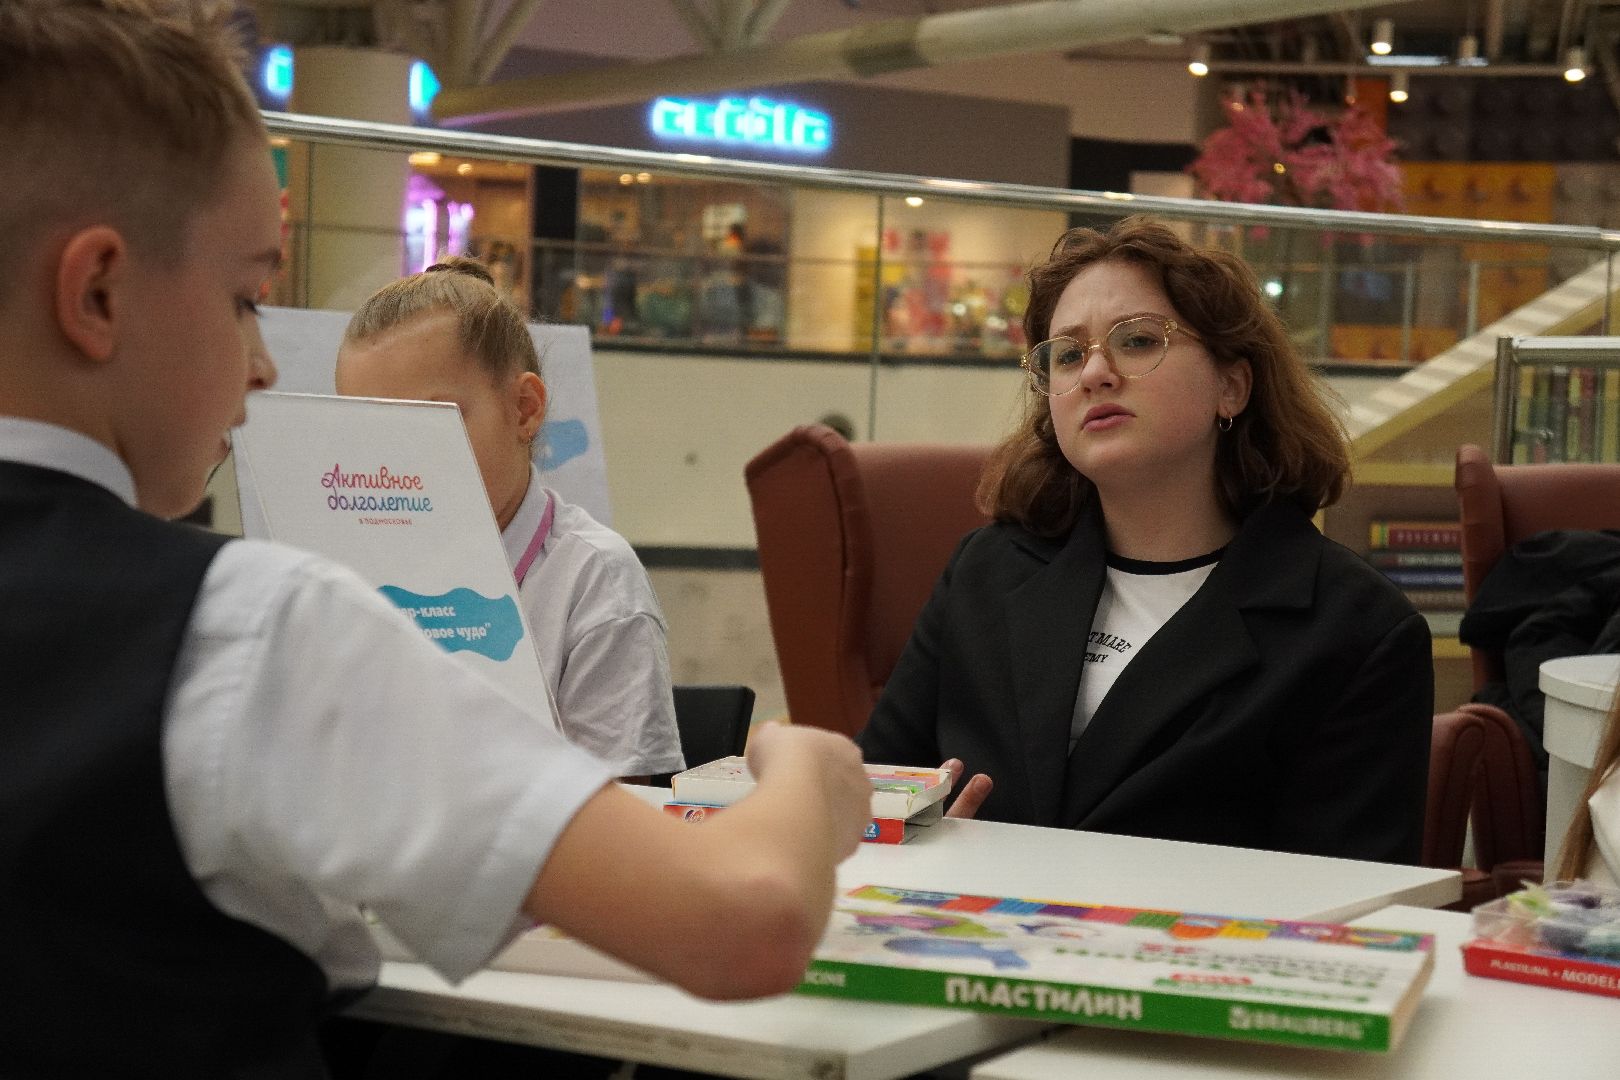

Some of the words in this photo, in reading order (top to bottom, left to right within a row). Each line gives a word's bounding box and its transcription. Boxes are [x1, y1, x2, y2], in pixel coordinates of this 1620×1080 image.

[321, 463, 424, 490] Активное
[327, 486, 433, 512] долголетие
[945, 976, 1142, 1021] ПЛАСТИЛИН
